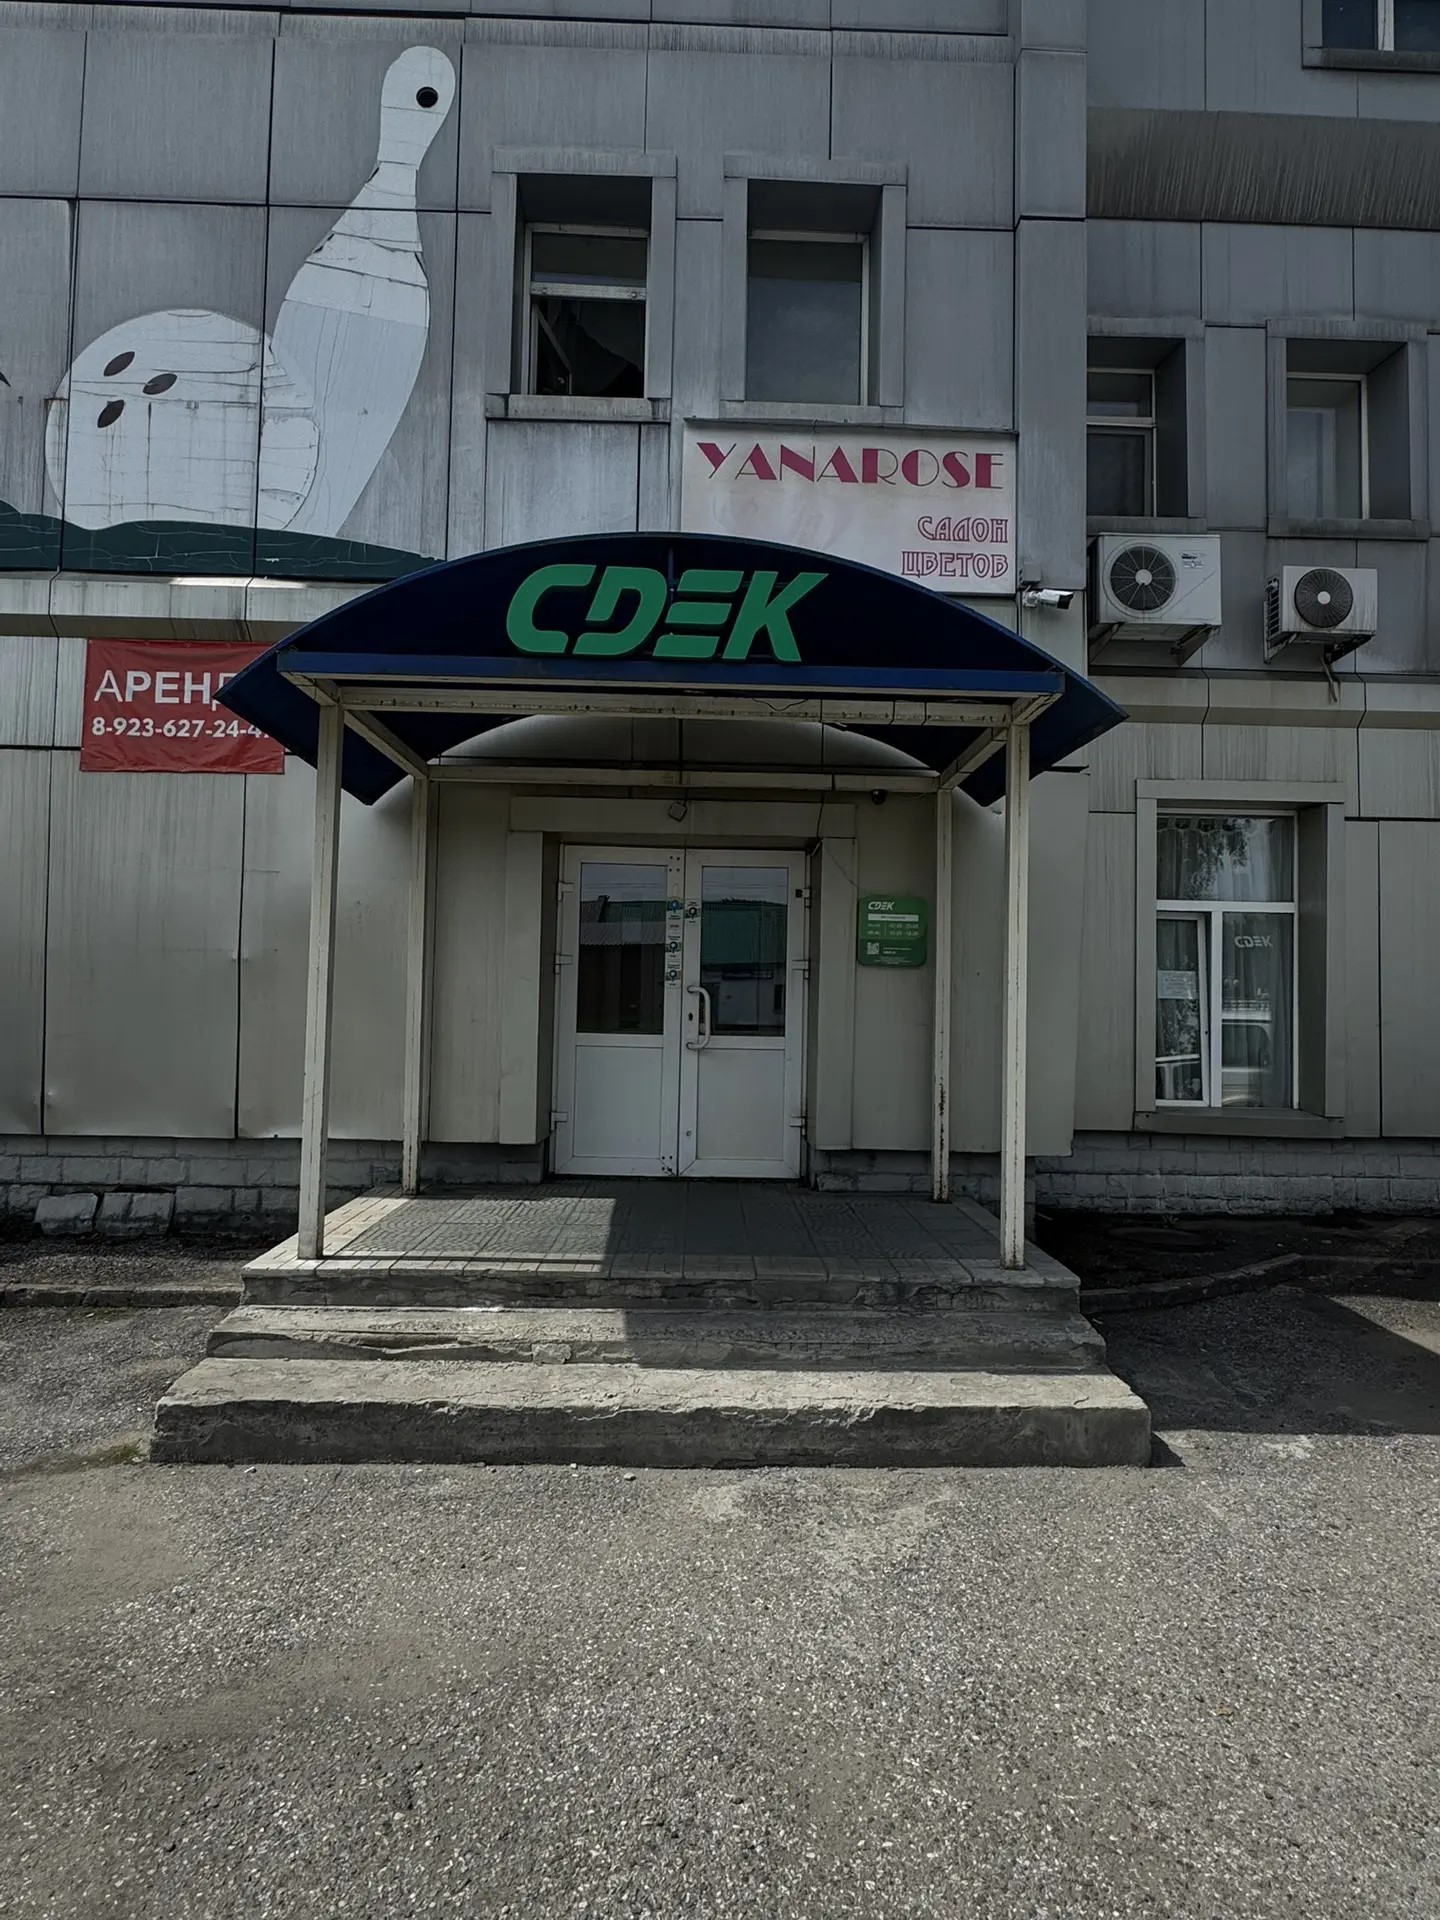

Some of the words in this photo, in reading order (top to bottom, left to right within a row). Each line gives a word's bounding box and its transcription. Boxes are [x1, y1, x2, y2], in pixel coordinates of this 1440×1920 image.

[697, 442, 1004, 489] YANAROSE
[917, 516, 1009, 543] САЛОН
[901, 551, 1009, 578] ЦВЕТОВ
[506, 564, 829, 662] CDEK
[92, 717, 269, 739] 8-923-627-24-4
[868, 901, 895, 910] CDEK
[1234, 935, 1274, 948] CDEK
